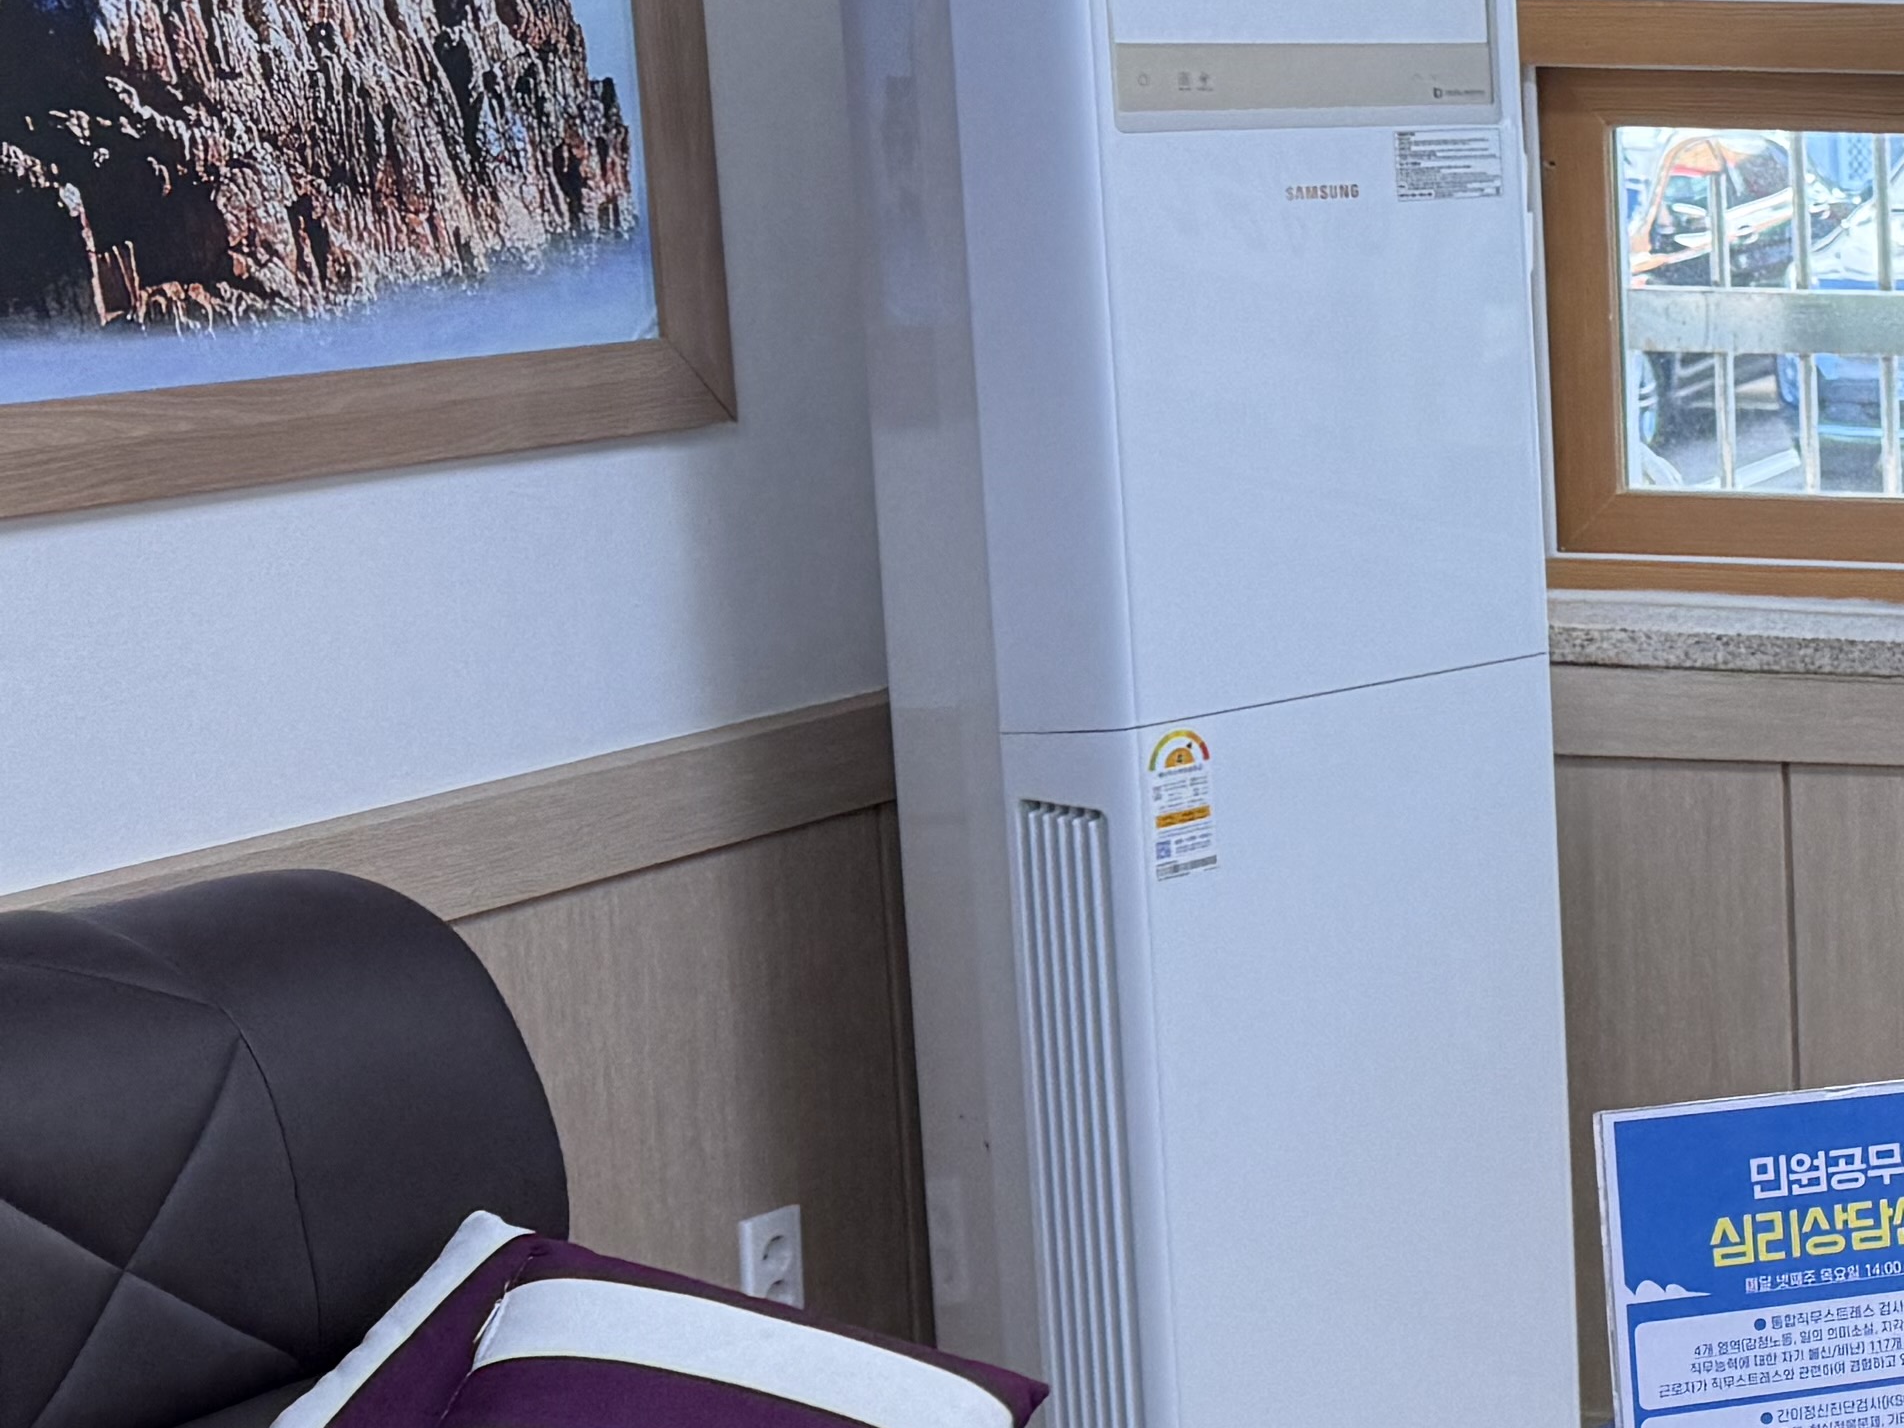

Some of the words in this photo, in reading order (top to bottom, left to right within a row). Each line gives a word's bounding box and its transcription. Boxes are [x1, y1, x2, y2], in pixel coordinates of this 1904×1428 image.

[1284, 183, 1360, 201] SAMSUNG
[1865, 1260, 1902, 1277] 14:00
[1771, 1304, 1876, 1330] 통합직무스트레스
[1782, 1349, 1805, 1364] 자기
[1869, 1336, 1903, 1353] 117개
[1658, 1380, 1708, 1400] 근로자가
[1711, 1367, 1795, 1391] 직무스트레스와
